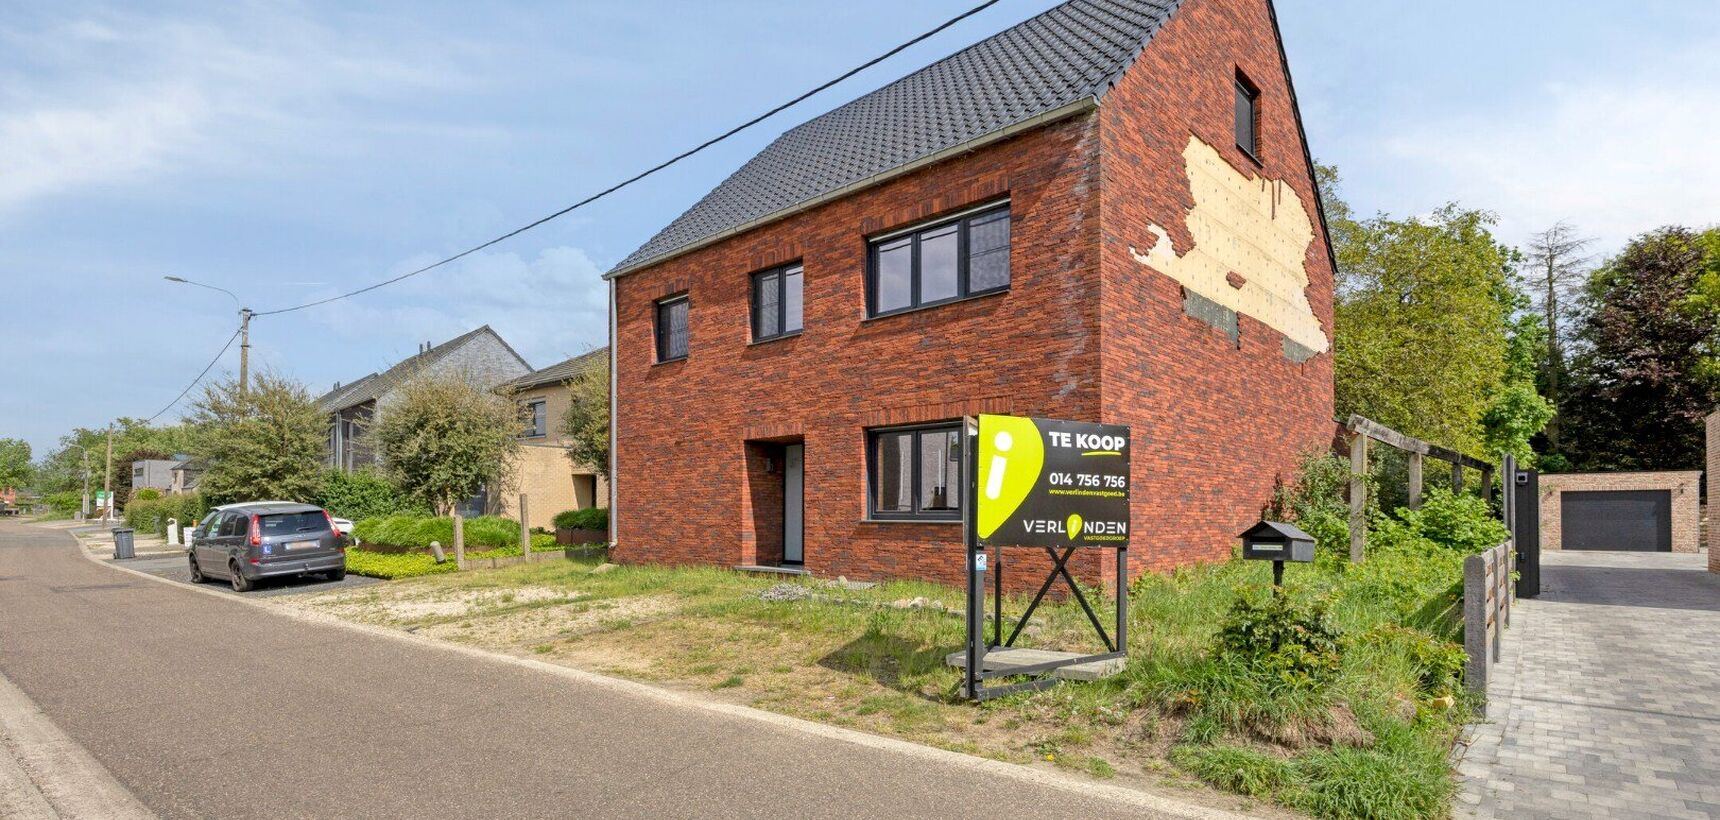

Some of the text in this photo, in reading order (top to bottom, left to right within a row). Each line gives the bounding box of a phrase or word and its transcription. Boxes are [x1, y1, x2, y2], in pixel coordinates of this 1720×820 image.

[1049, 431, 1125, 451] TE KOOP
[1049, 472, 1125, 488] 014 756 756
[1049, 489, 1125, 498] www.verlindenvastgoed.be
